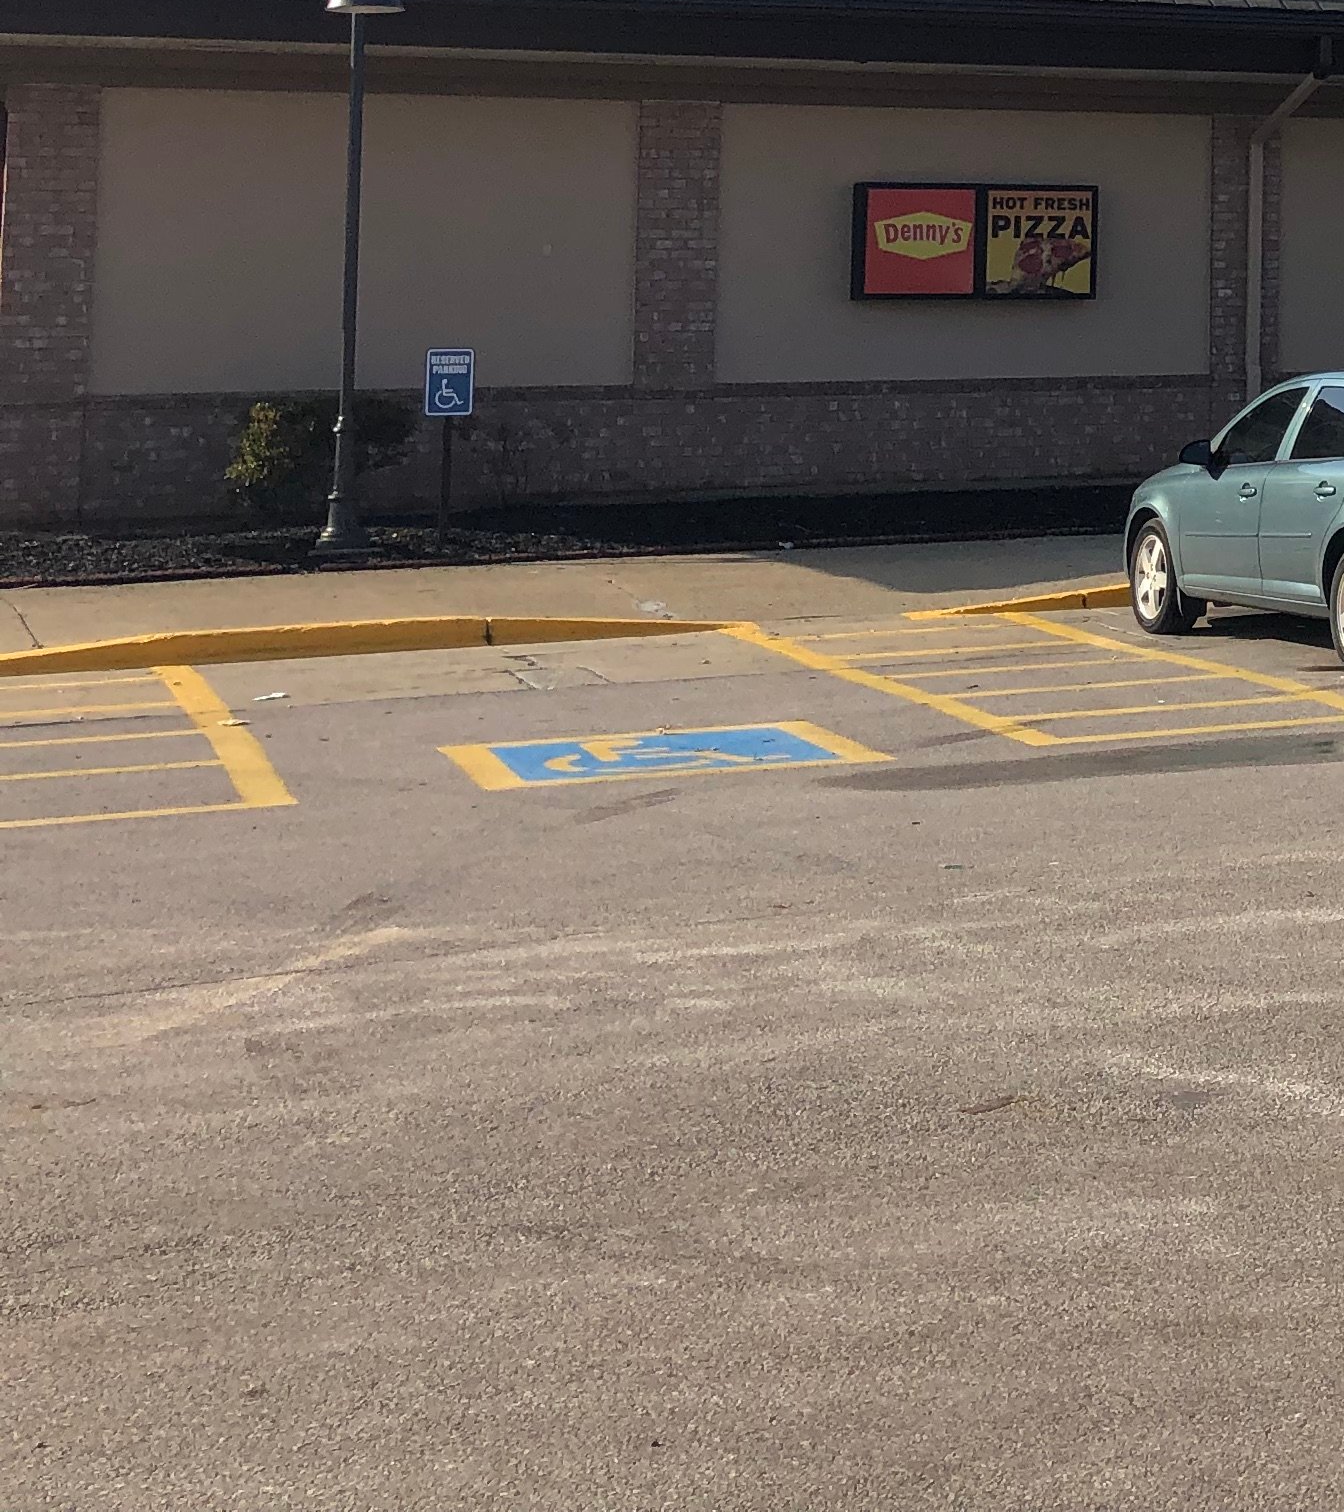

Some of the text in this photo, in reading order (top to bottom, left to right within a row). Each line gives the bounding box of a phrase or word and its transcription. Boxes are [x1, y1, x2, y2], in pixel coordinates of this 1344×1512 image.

[991, 196, 1091, 212] HOT FRESH
[882, 221, 965, 246] Denny's
[990, 214, 1091, 240] PIZZA
